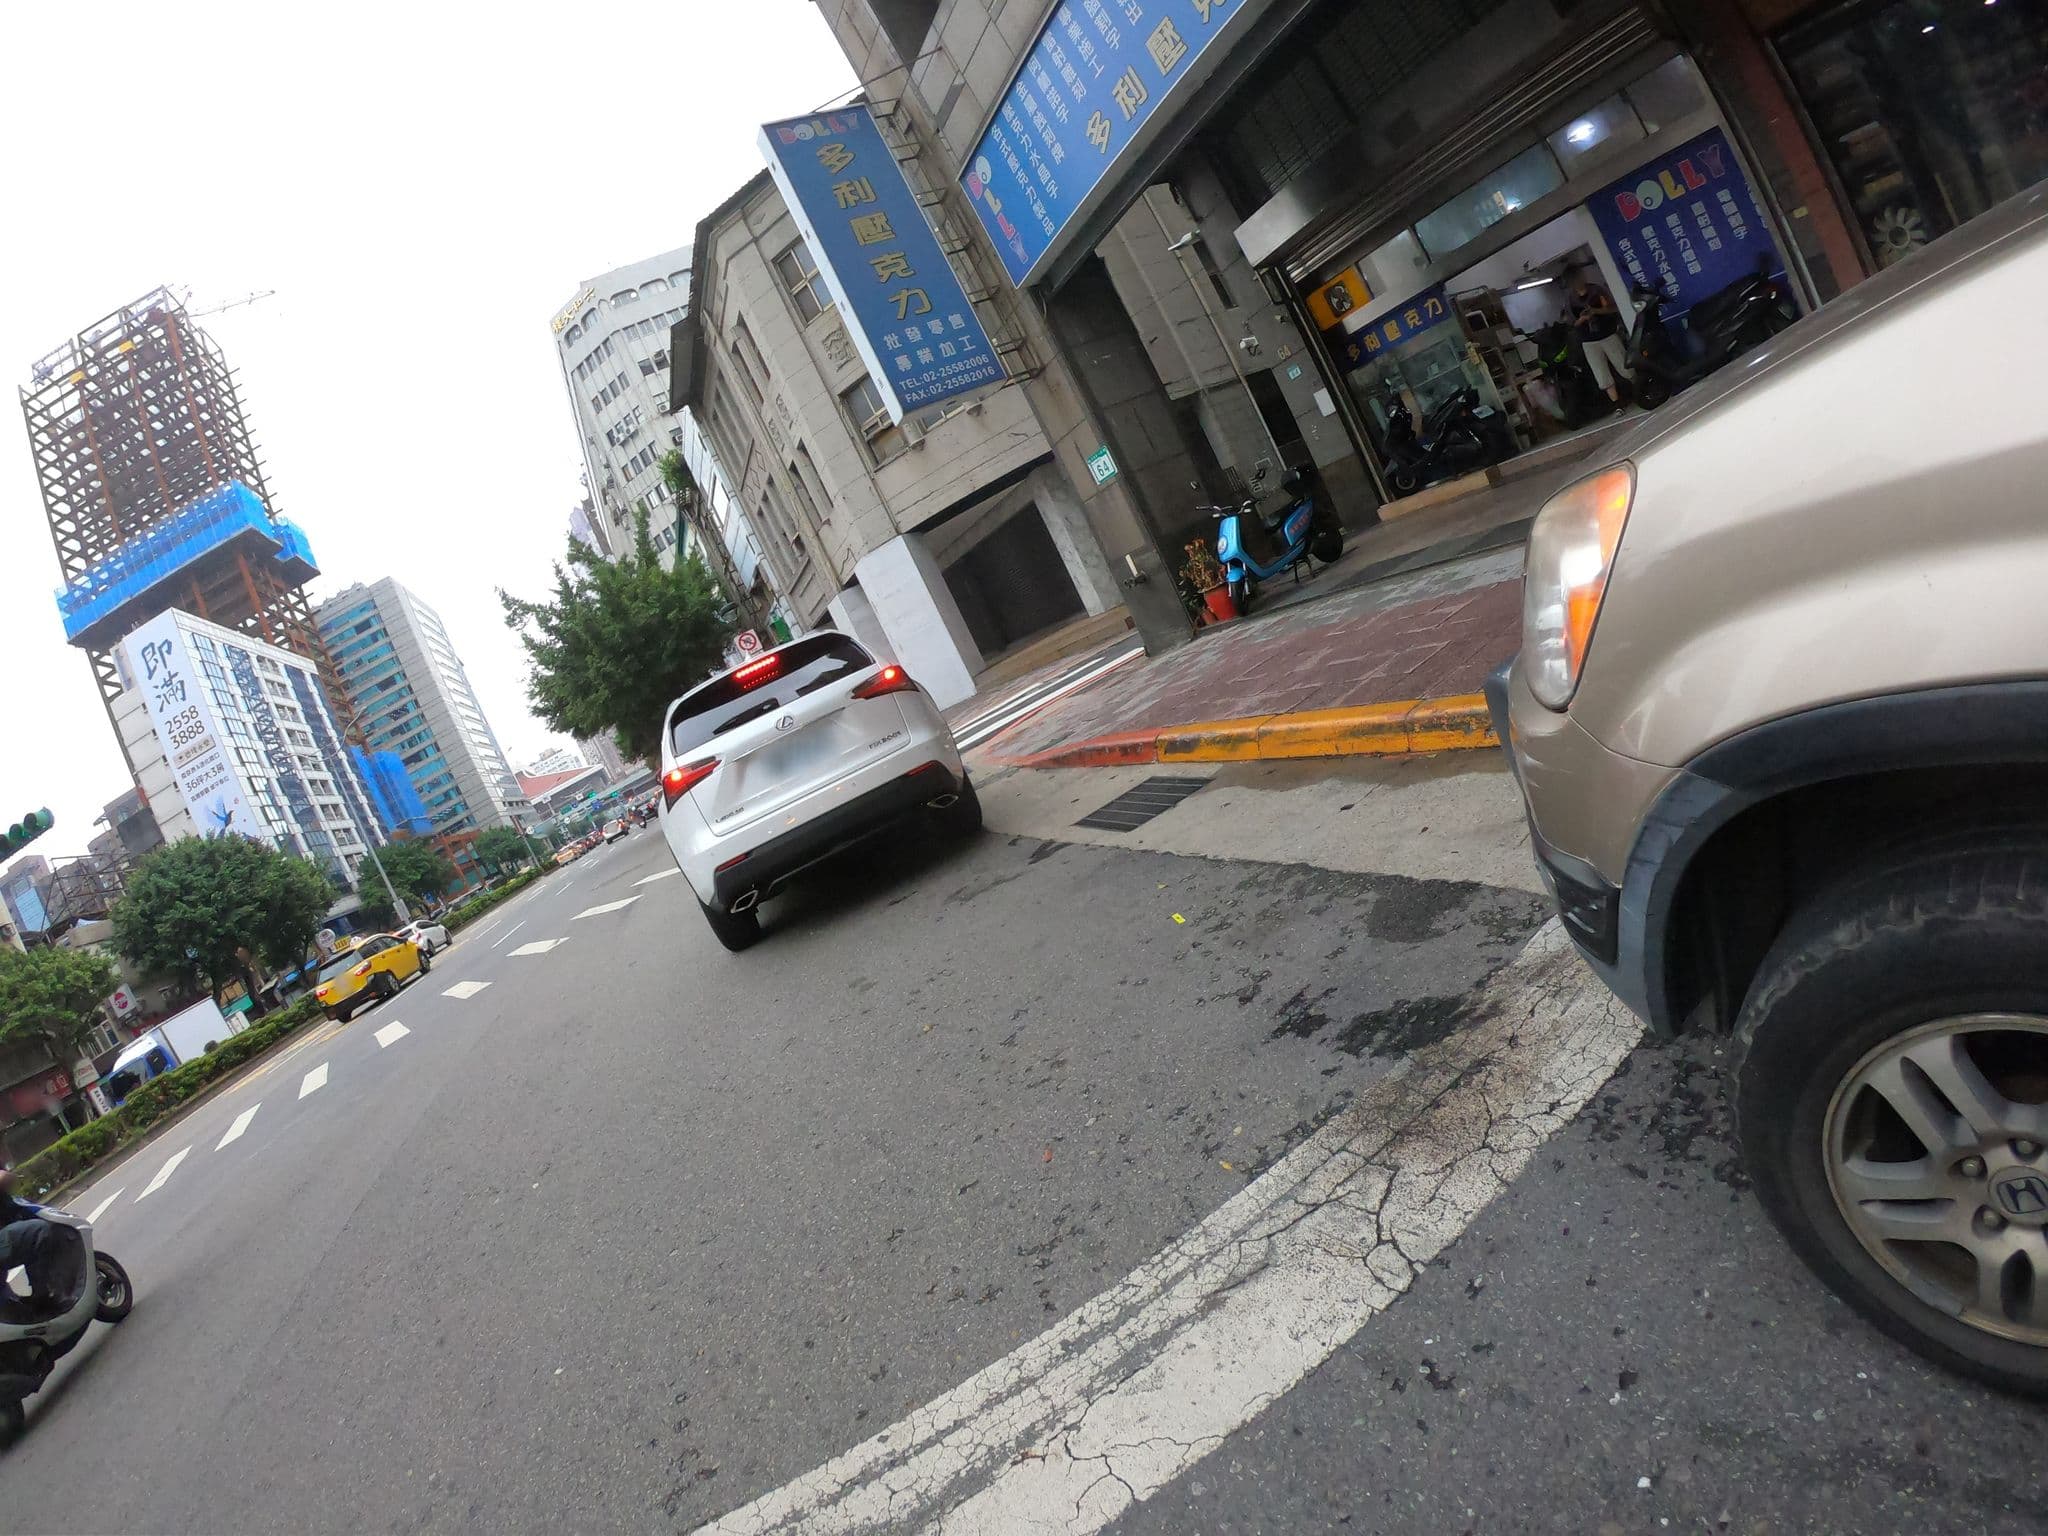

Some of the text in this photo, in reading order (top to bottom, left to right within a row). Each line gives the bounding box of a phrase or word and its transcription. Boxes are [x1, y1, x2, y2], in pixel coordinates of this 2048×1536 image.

[777, 113, 858, 144] DOLLY
[1614, 144, 1725, 222] DOLLY
[815, 142, 933, 321] 多利壓克力
[883, 313, 965, 350] 批發零售
[894, 334, 976, 373] 專業加工
[1097, 460, 1109, 476] 64
[165, 704, 199, 735] 2558
[171, 720, 205, 750] 3888
